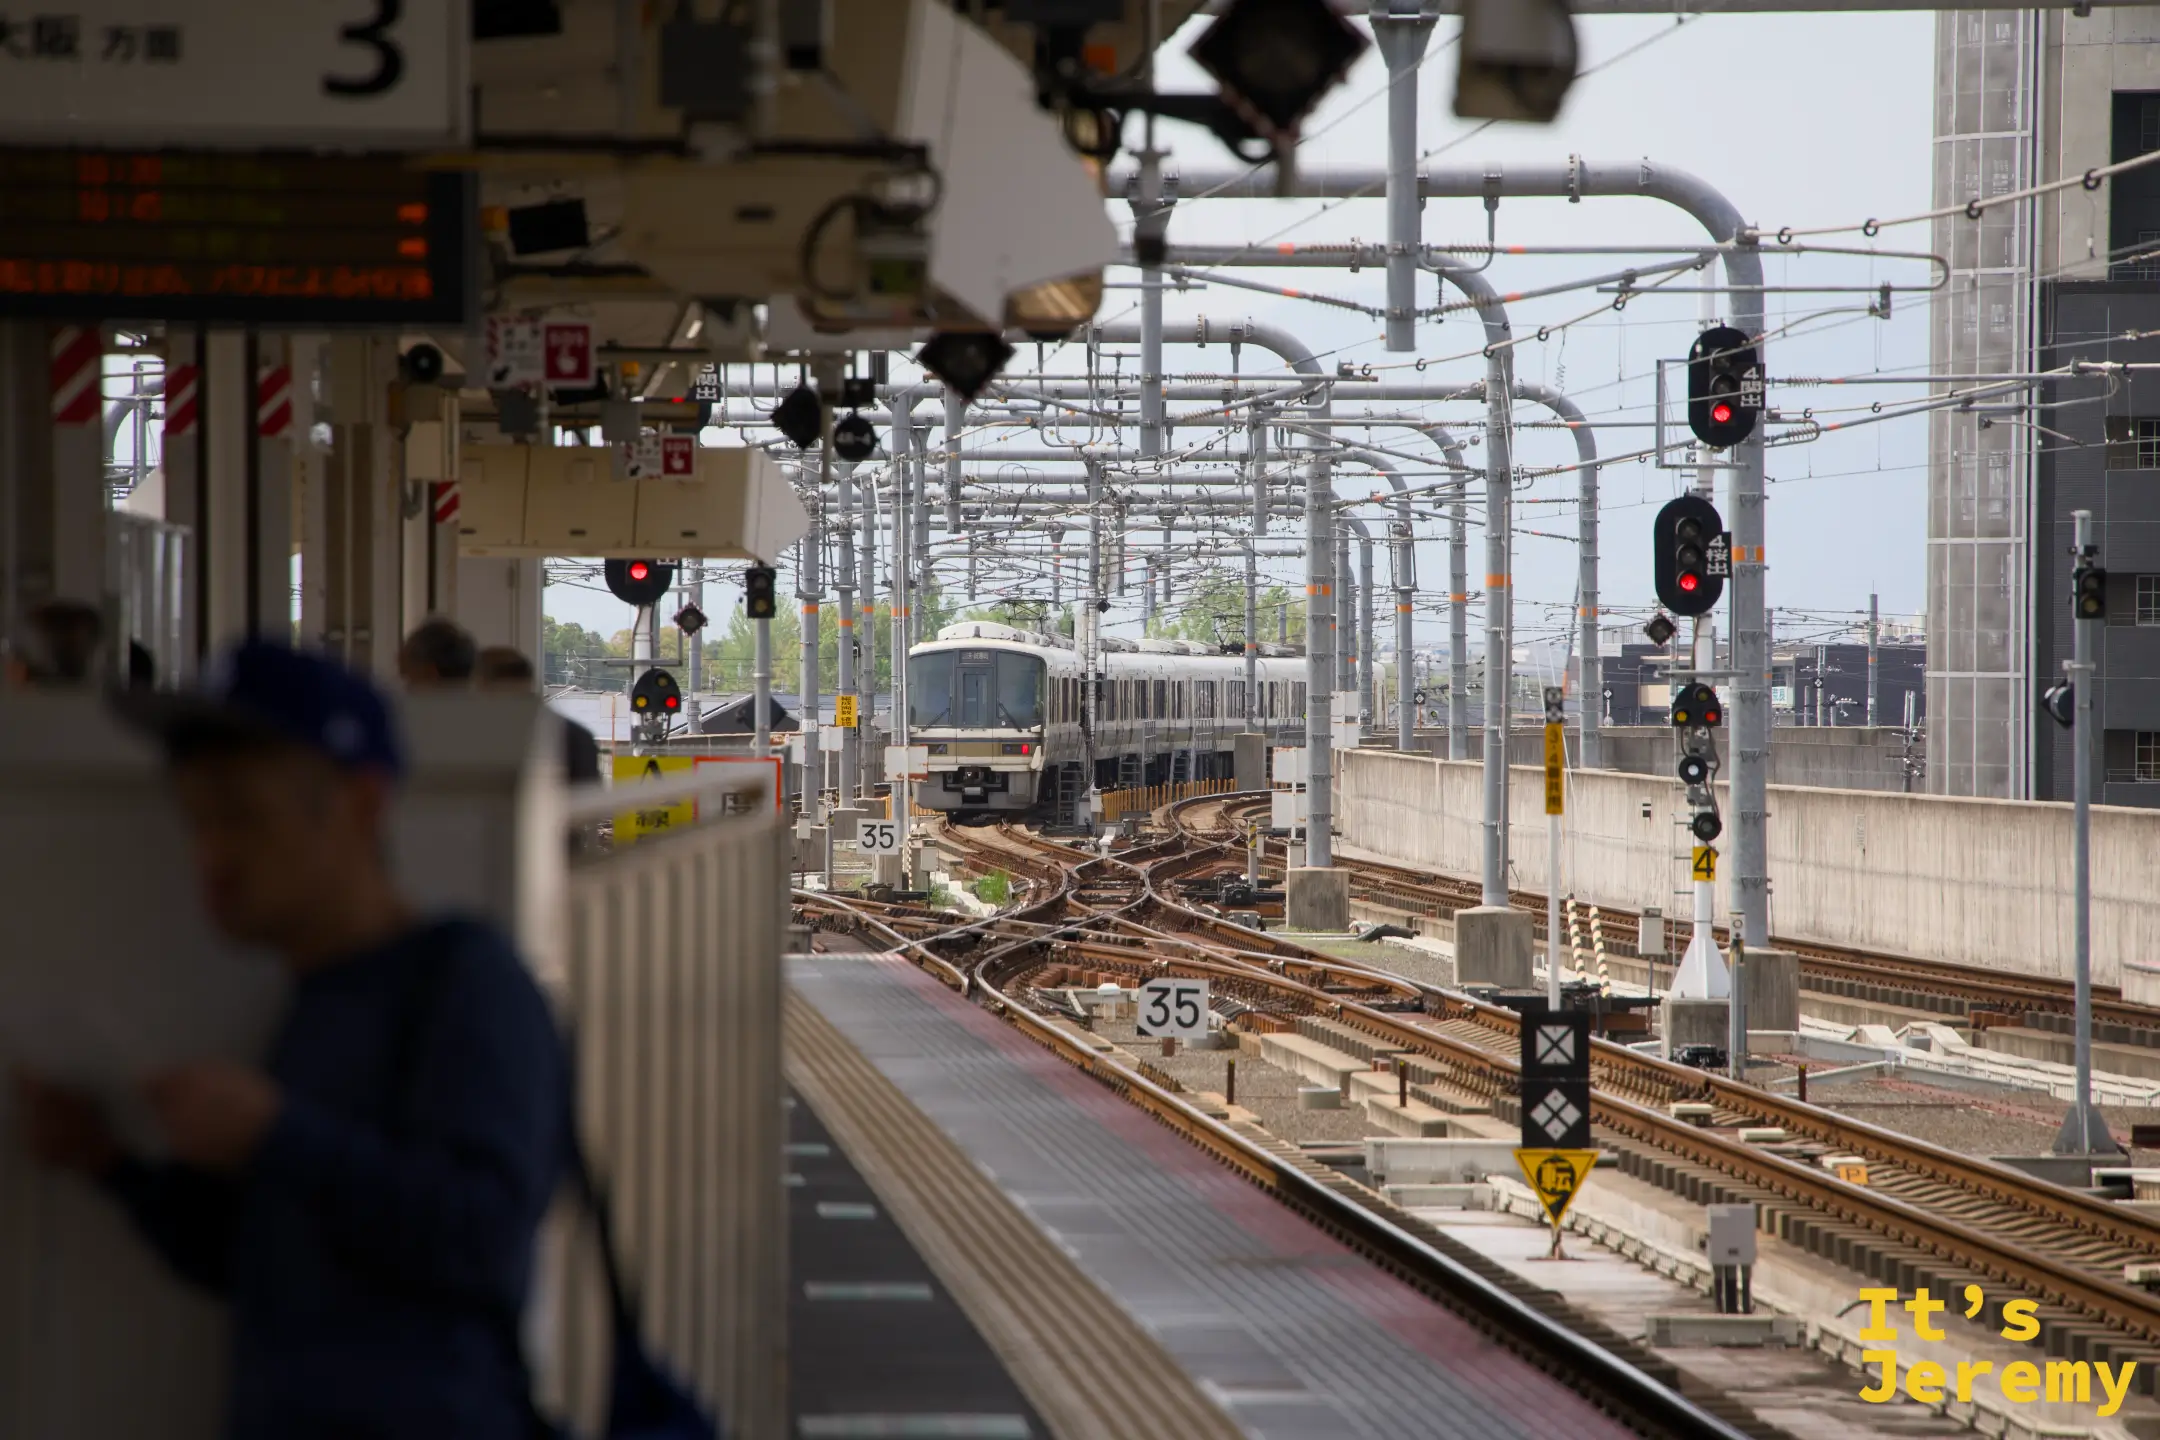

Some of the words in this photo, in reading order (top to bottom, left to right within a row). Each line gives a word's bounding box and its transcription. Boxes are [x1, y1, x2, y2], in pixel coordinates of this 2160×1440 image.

[325, 0, 403, 94] 3
[861, 824, 895, 849] 35
[1693, 847, 1714, 879] 4
[1146, 986, 1201, 1029] 35
